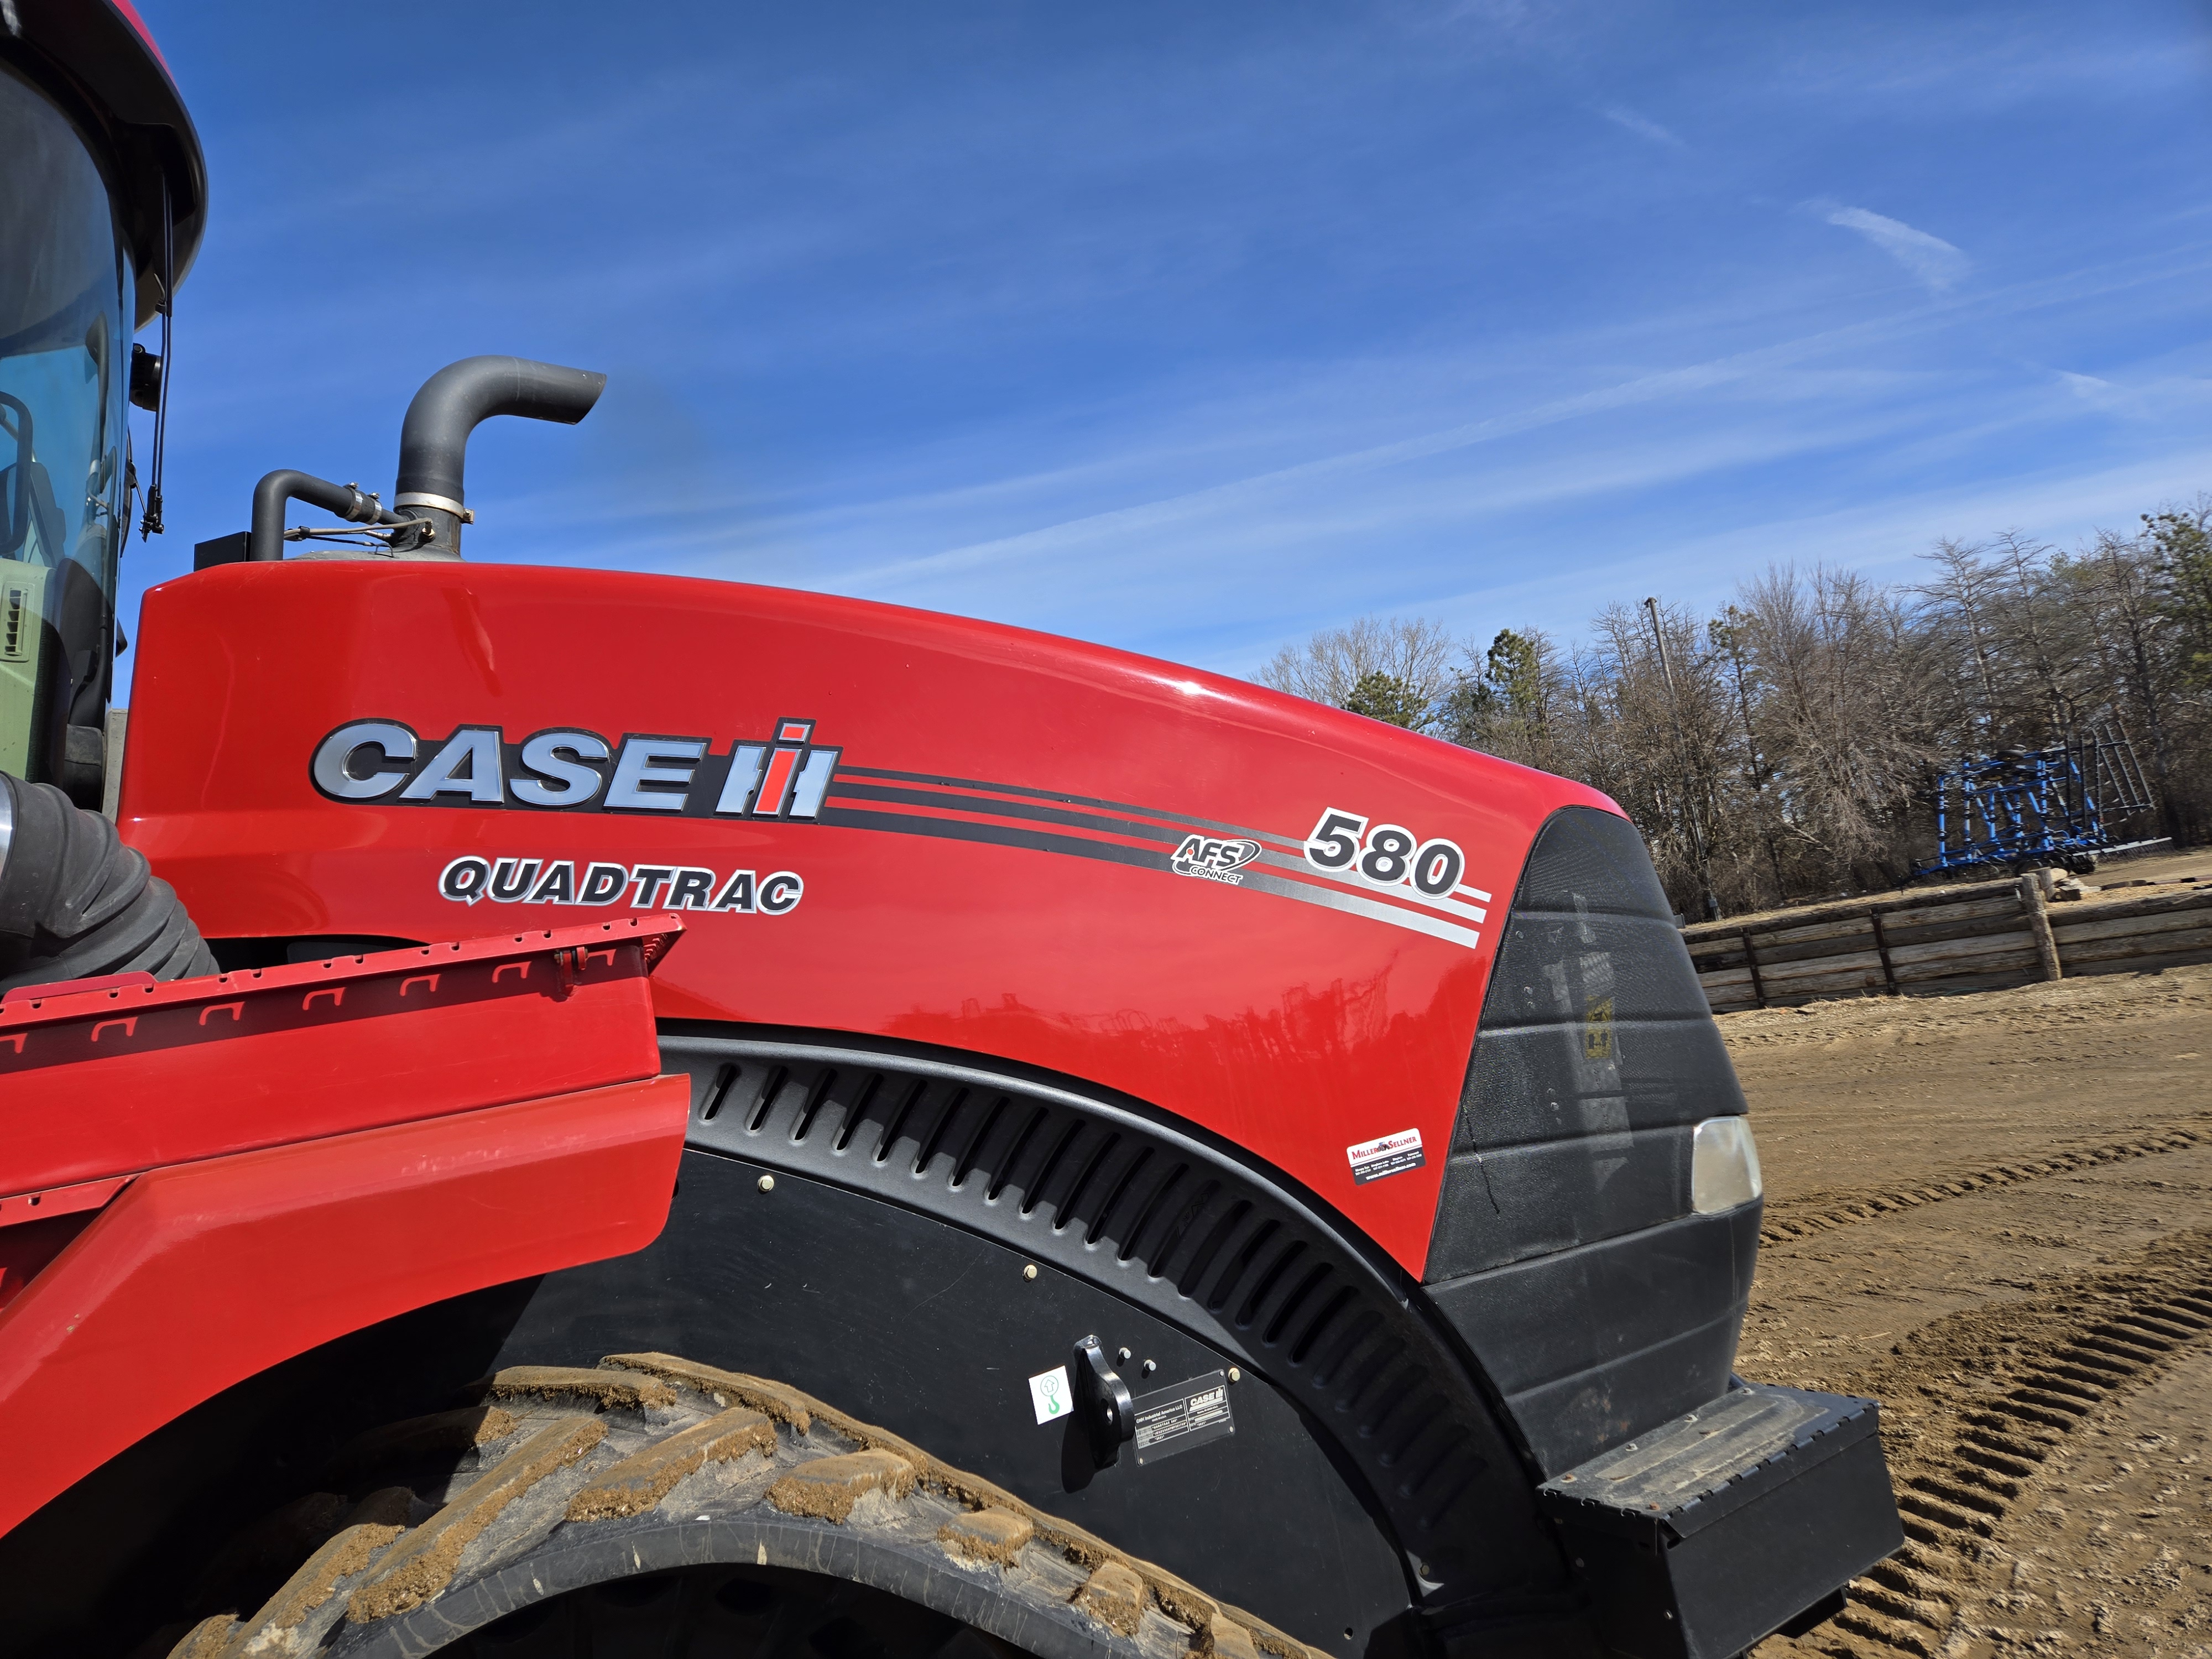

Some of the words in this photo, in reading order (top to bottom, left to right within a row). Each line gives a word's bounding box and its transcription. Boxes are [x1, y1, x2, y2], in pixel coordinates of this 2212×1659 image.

[312, 722, 707, 812] CASE
[1176, 837, 1240, 867] AFS
[1305, 808, 1464, 898] 580
[441, 857, 803, 914] QUADTRAC
[1191, 866, 1241, 883] CONNECT
[1352, 1147, 1378, 1160] MILLER
[1388, 1136, 1417, 1149] SELLNER
[1191, 1392, 1214, 1406] CASE
